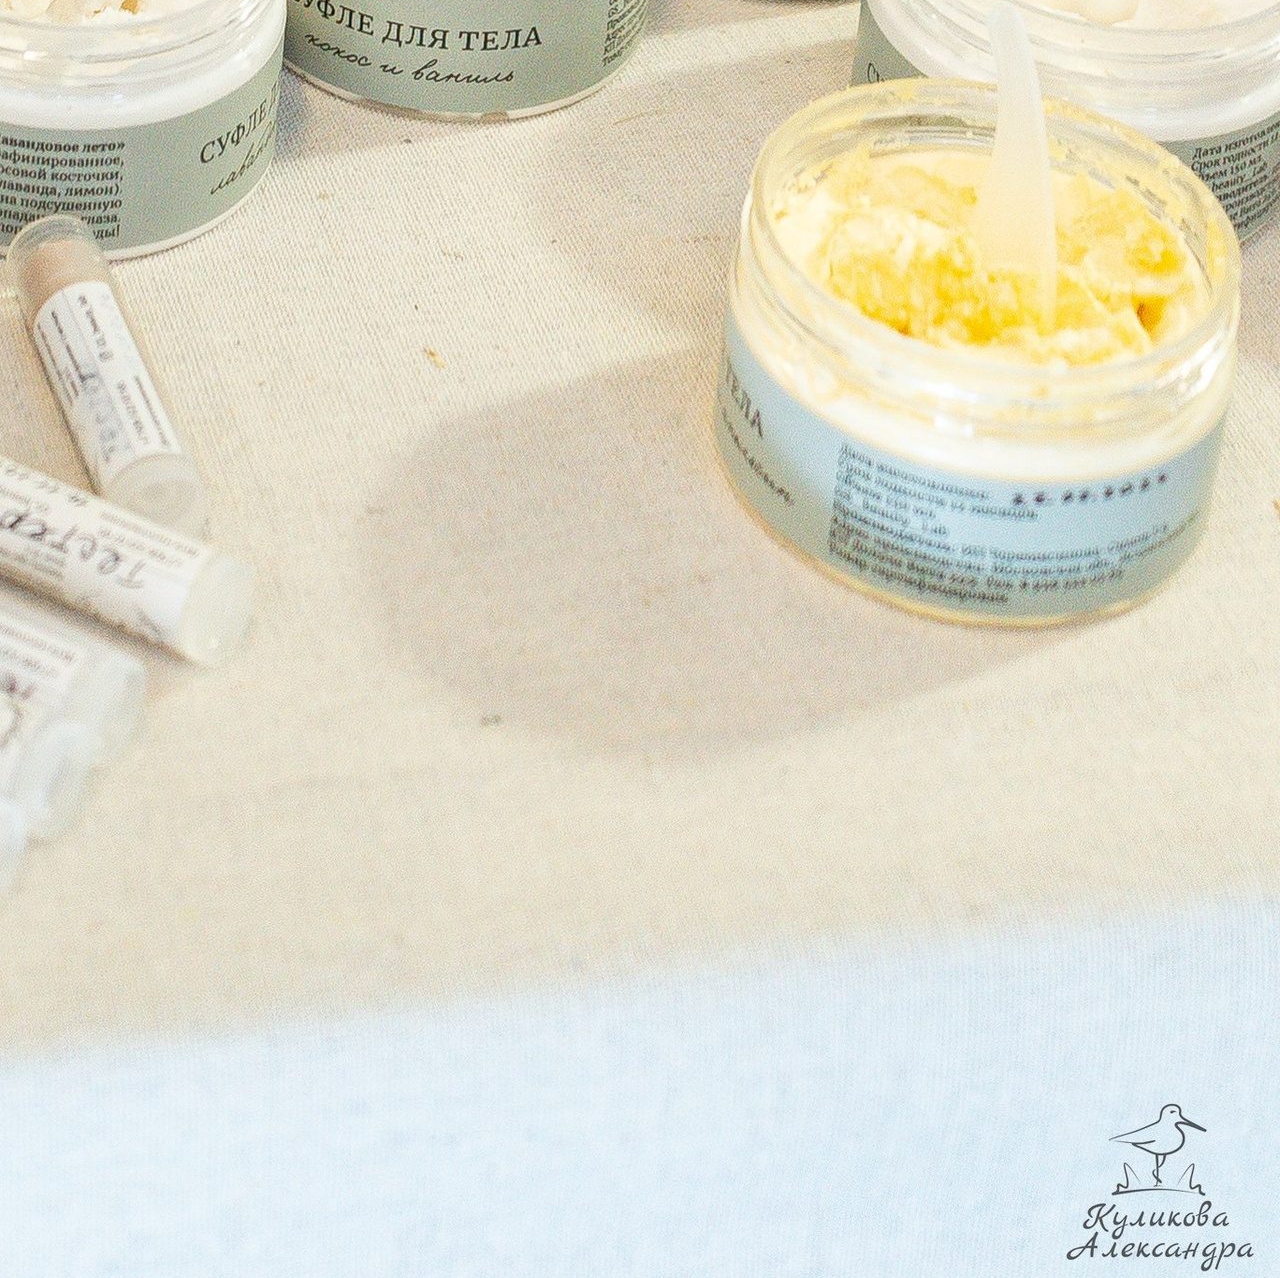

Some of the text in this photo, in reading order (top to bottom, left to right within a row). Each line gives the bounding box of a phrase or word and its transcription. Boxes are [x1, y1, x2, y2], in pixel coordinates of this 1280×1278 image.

[305, 32, 516, 85] кокос и ваниль
[382, 20, 449, 50] ДЛЯ
[459, 25, 543, 52] ТЕЛА
[199, 98, 267, 164] СУФЛЕ
